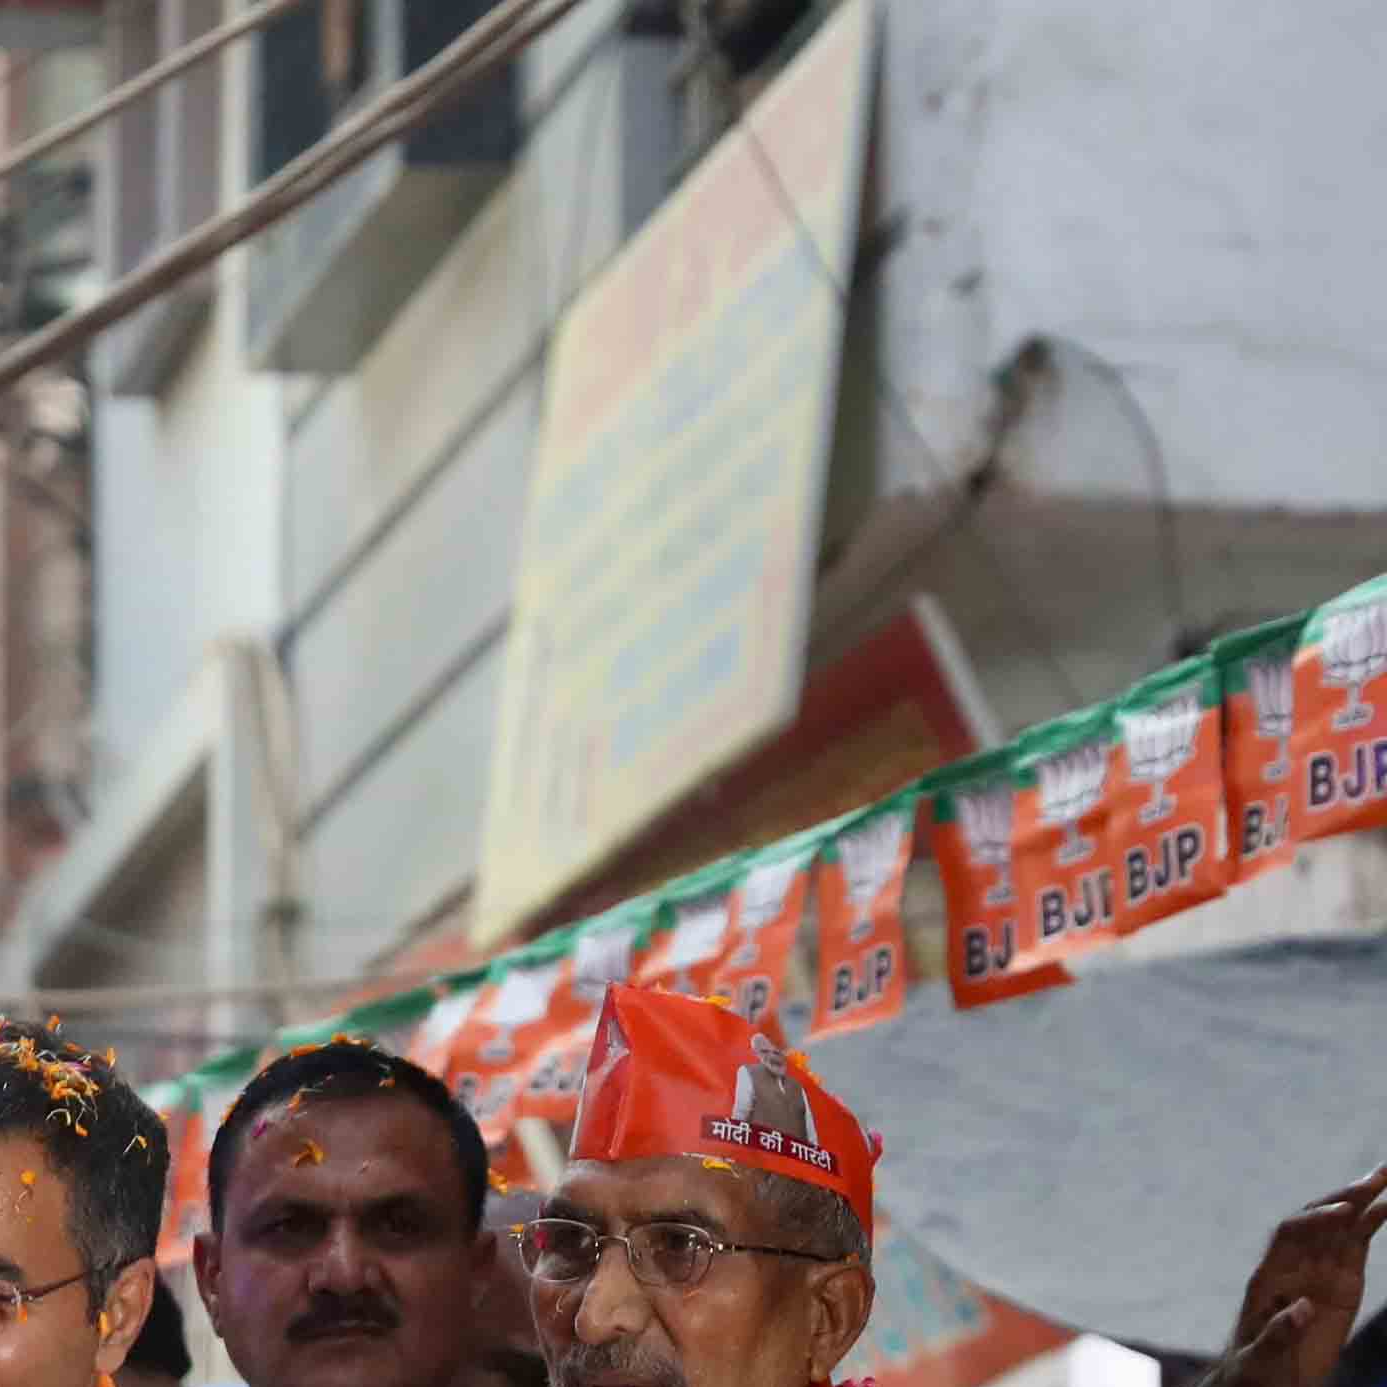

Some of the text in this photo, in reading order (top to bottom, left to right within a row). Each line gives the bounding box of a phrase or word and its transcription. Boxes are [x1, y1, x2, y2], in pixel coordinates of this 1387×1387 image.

[1127, 828, 1199, 900] BJP
[964, 926, 1013, 977] BJ
[712, 1119, 751, 1145] मोदी
[759, 1131, 783, 1152] की
